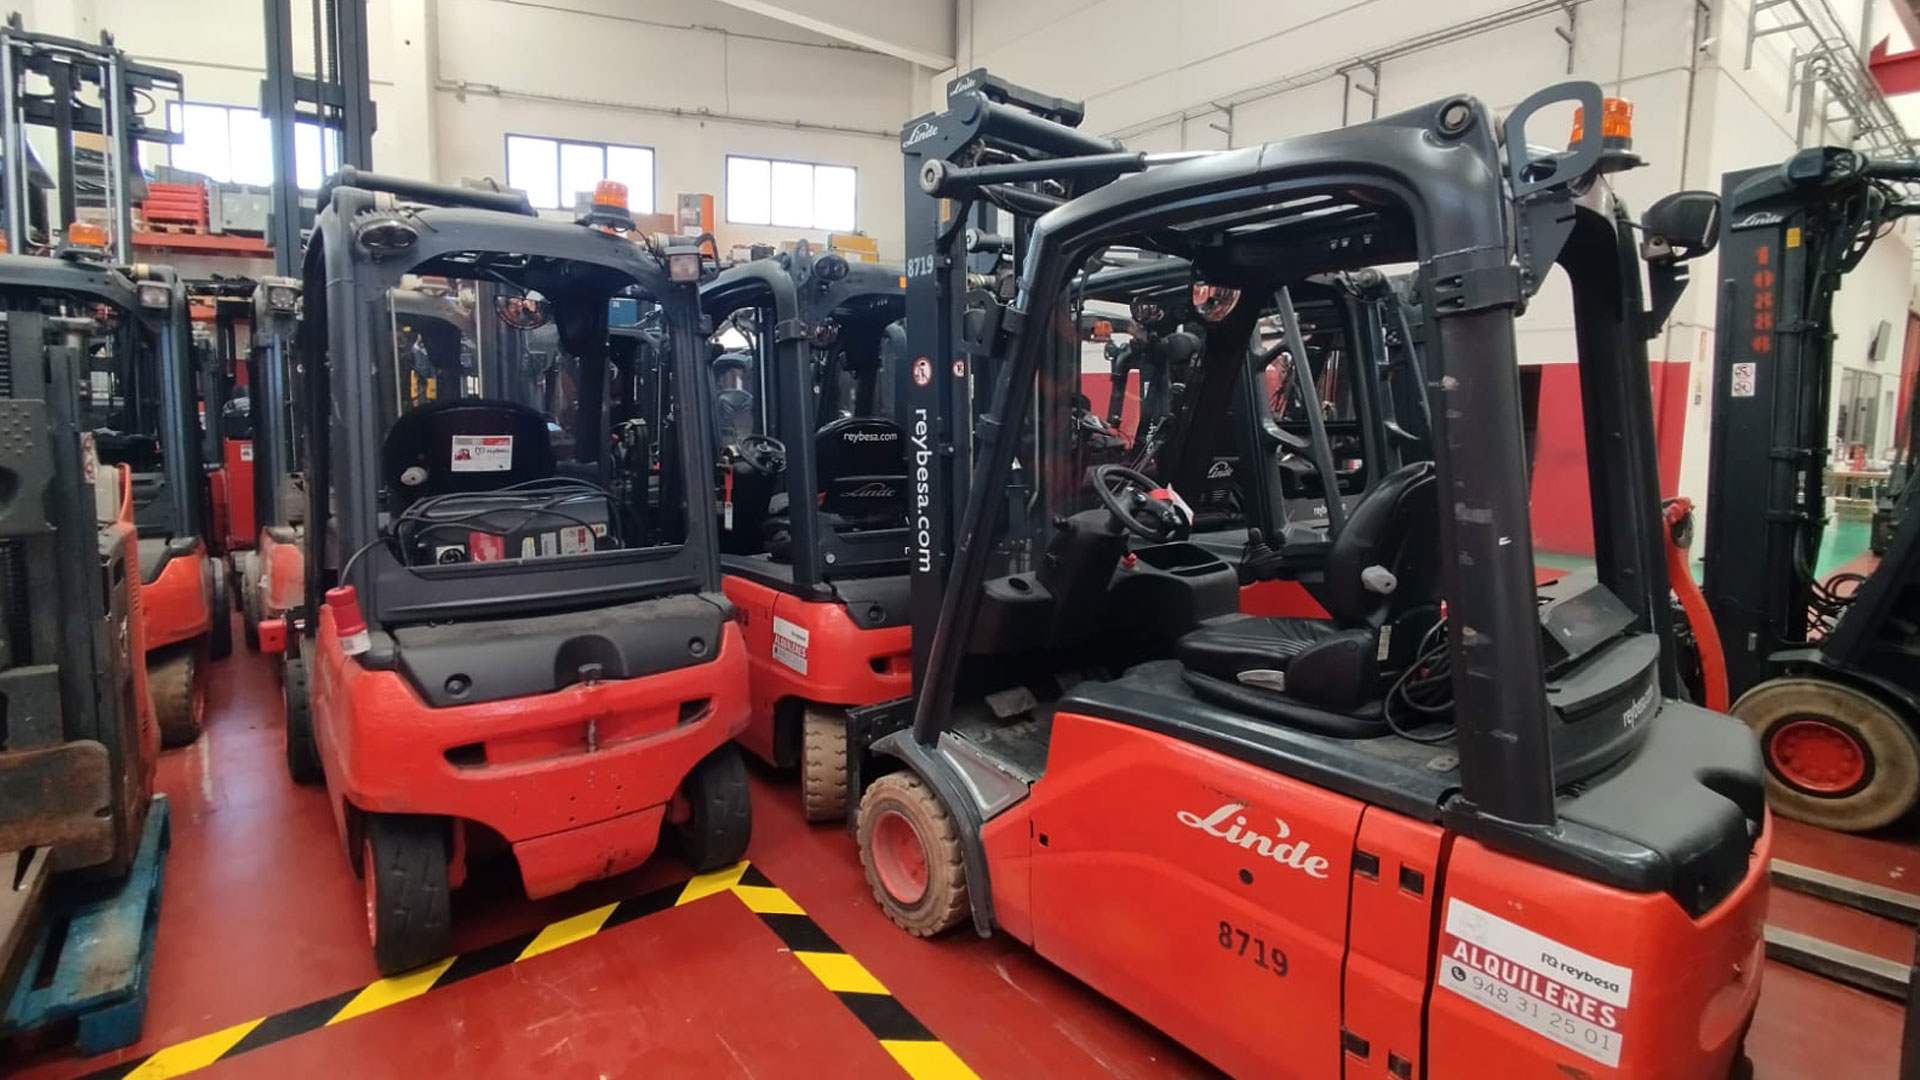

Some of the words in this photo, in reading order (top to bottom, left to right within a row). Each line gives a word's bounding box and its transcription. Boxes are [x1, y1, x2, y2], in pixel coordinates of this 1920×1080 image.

[902, 122, 938, 148] Linde
[1731, 212, 1785, 228] Linde
[908, 254, 934, 278] 8719
[843, 431, 898, 443] reybesa.com
[840, 482, 896, 497] Linde
[911, 408, 933, 573] reybesa.com
[1177, 803, 1329, 878] Linde
[1219, 920, 1288, 977] 8719
[1452, 941, 1617, 1029] ALQUILERES
[1560, 962, 1619, 994] reybesa
[1472, 975, 1510, 1004] 948
[1516, 996, 1539, 1019] 31
[1549, 1012, 1576, 1035] 25
[1585, 1028, 1610, 1051] 01
